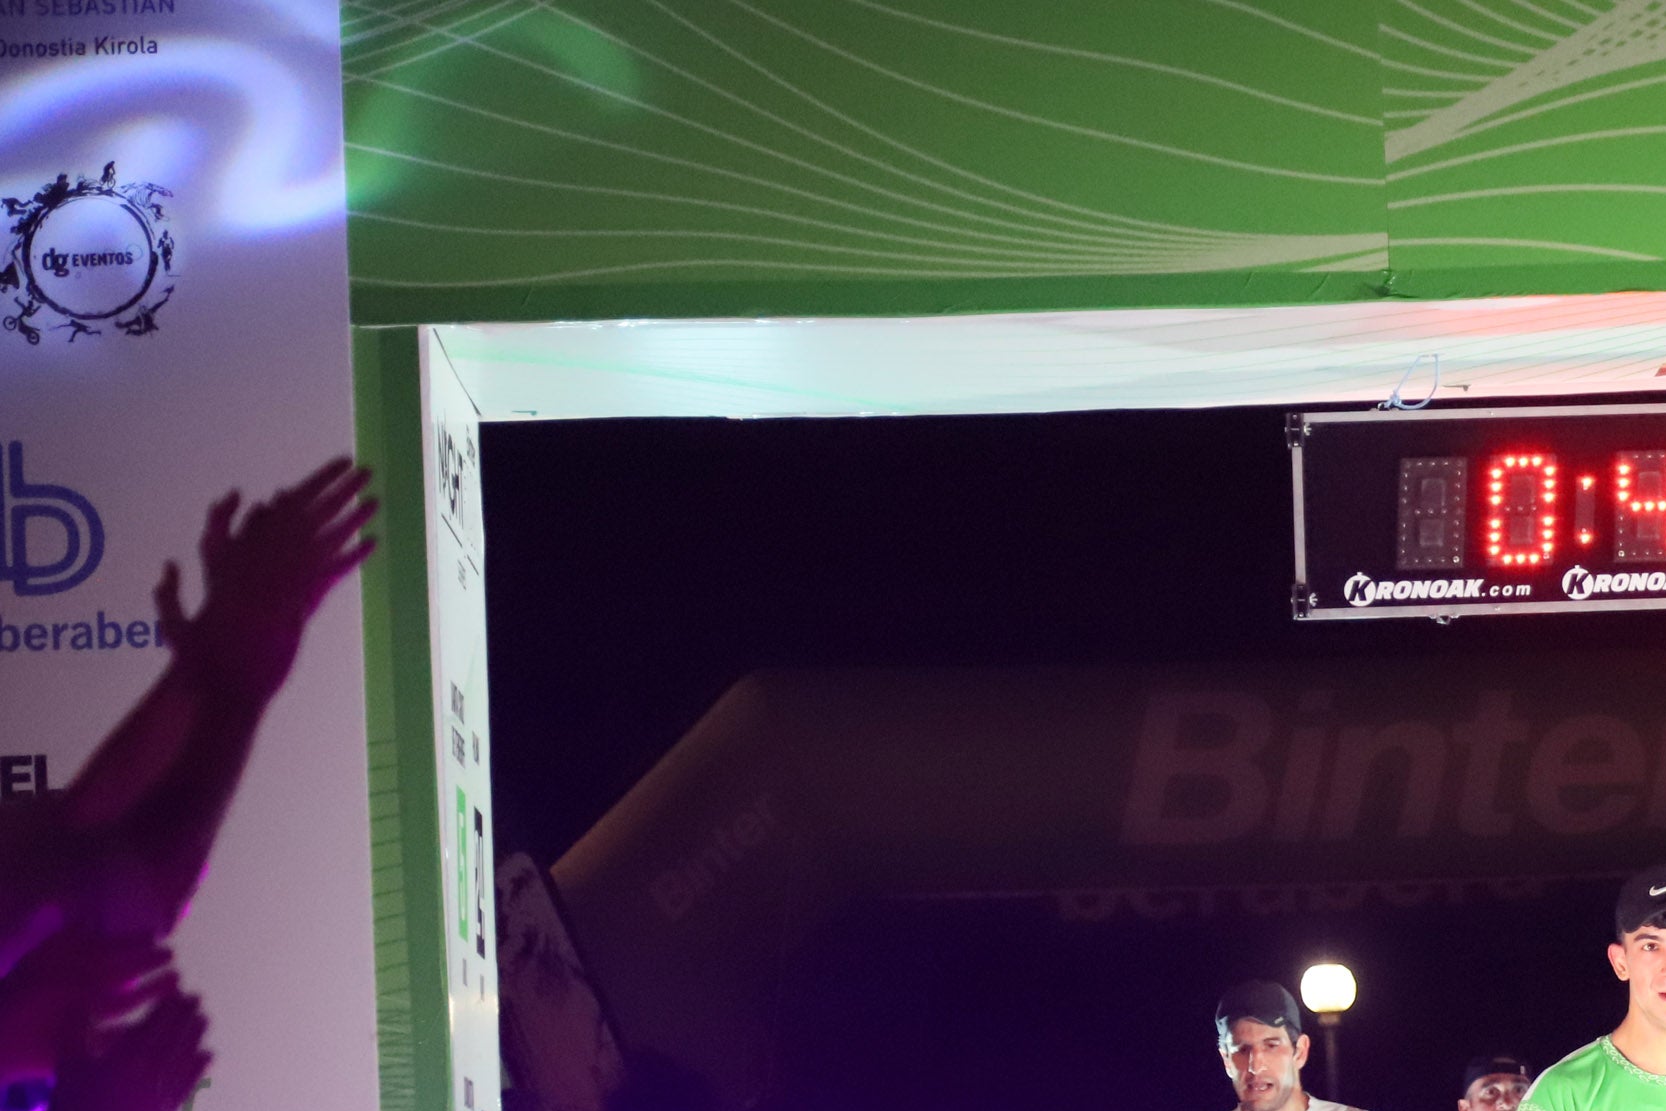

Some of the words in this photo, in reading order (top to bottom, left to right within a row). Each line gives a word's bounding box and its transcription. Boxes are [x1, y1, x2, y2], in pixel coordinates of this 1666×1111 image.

[94, 36, 158, 55] Kirola
[42, 247, 69, 278] dg
[71, 251, 133, 267] EVENTOS
[1345, 574, 1531, 606] KRONOAK.com
